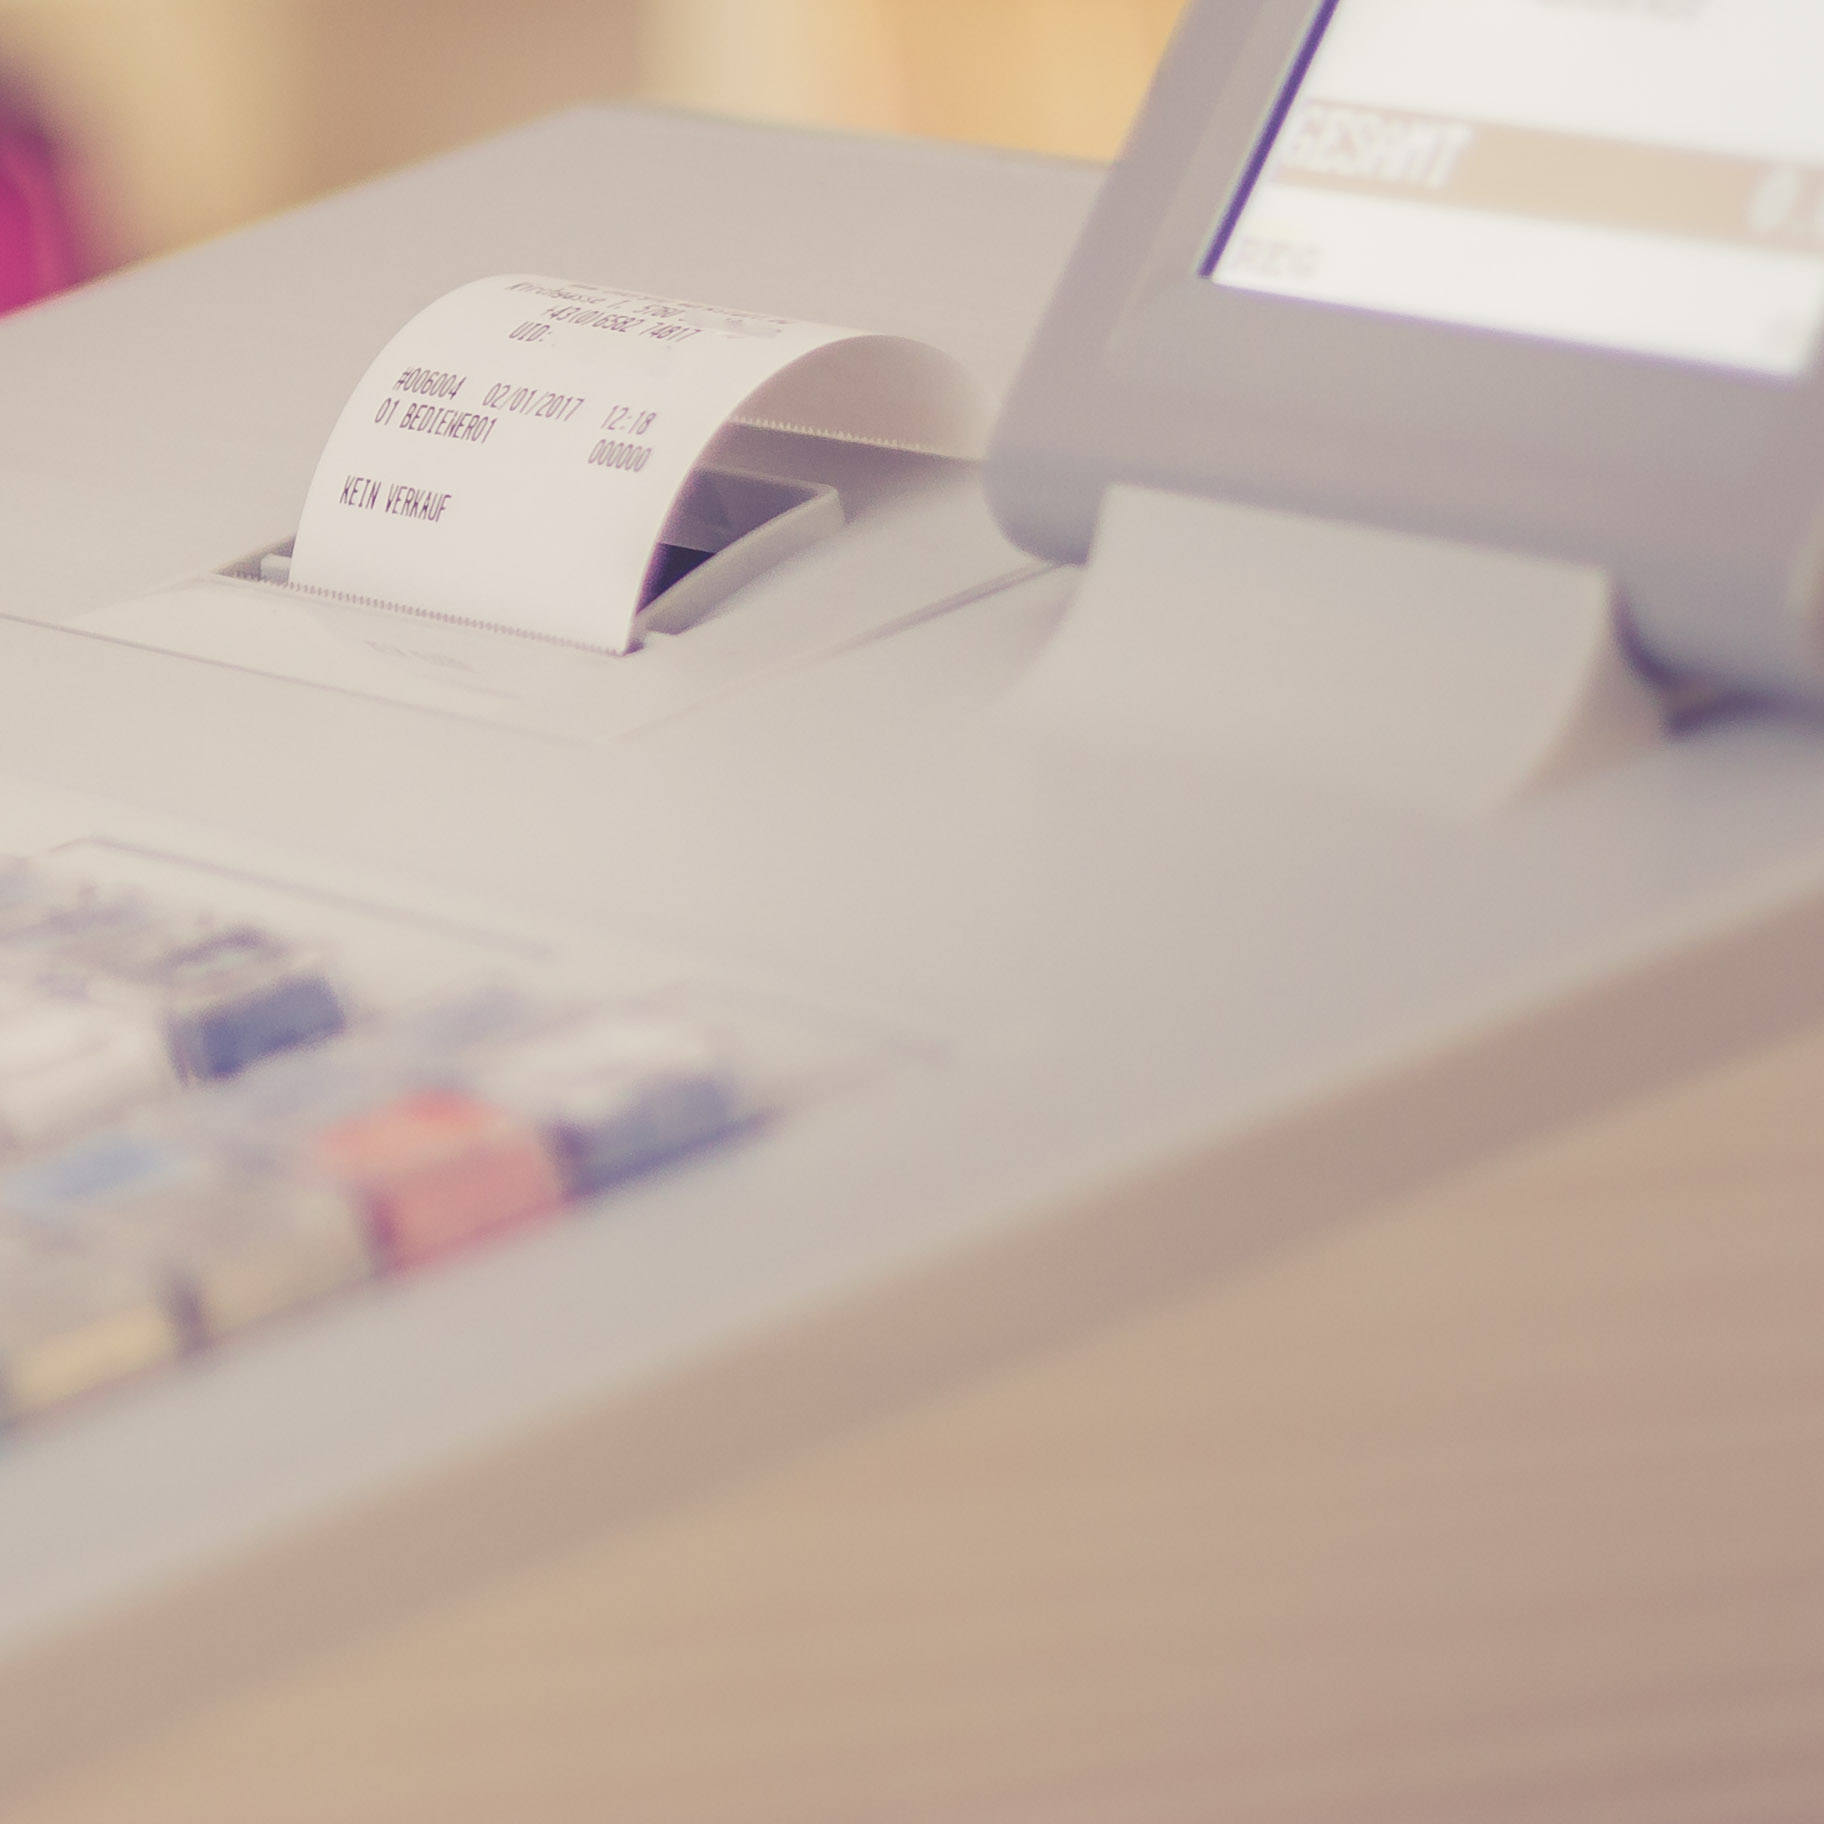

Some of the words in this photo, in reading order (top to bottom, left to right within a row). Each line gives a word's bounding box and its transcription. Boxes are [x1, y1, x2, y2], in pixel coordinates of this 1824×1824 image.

[640, 321, 702, 343] 74817
[392, 366, 467, 400] #006004
[482, 382, 584, 422] 02/01/2017
[600, 405, 657, 435] 12:18
[374, 397, 400, 425] 01
[399, 402, 497, 444] BEDIENER01
[587, 438, 652, 473] 000000
[339, 475, 382, 509] KEIN
[385, 483, 452, 522] VERKAUF
